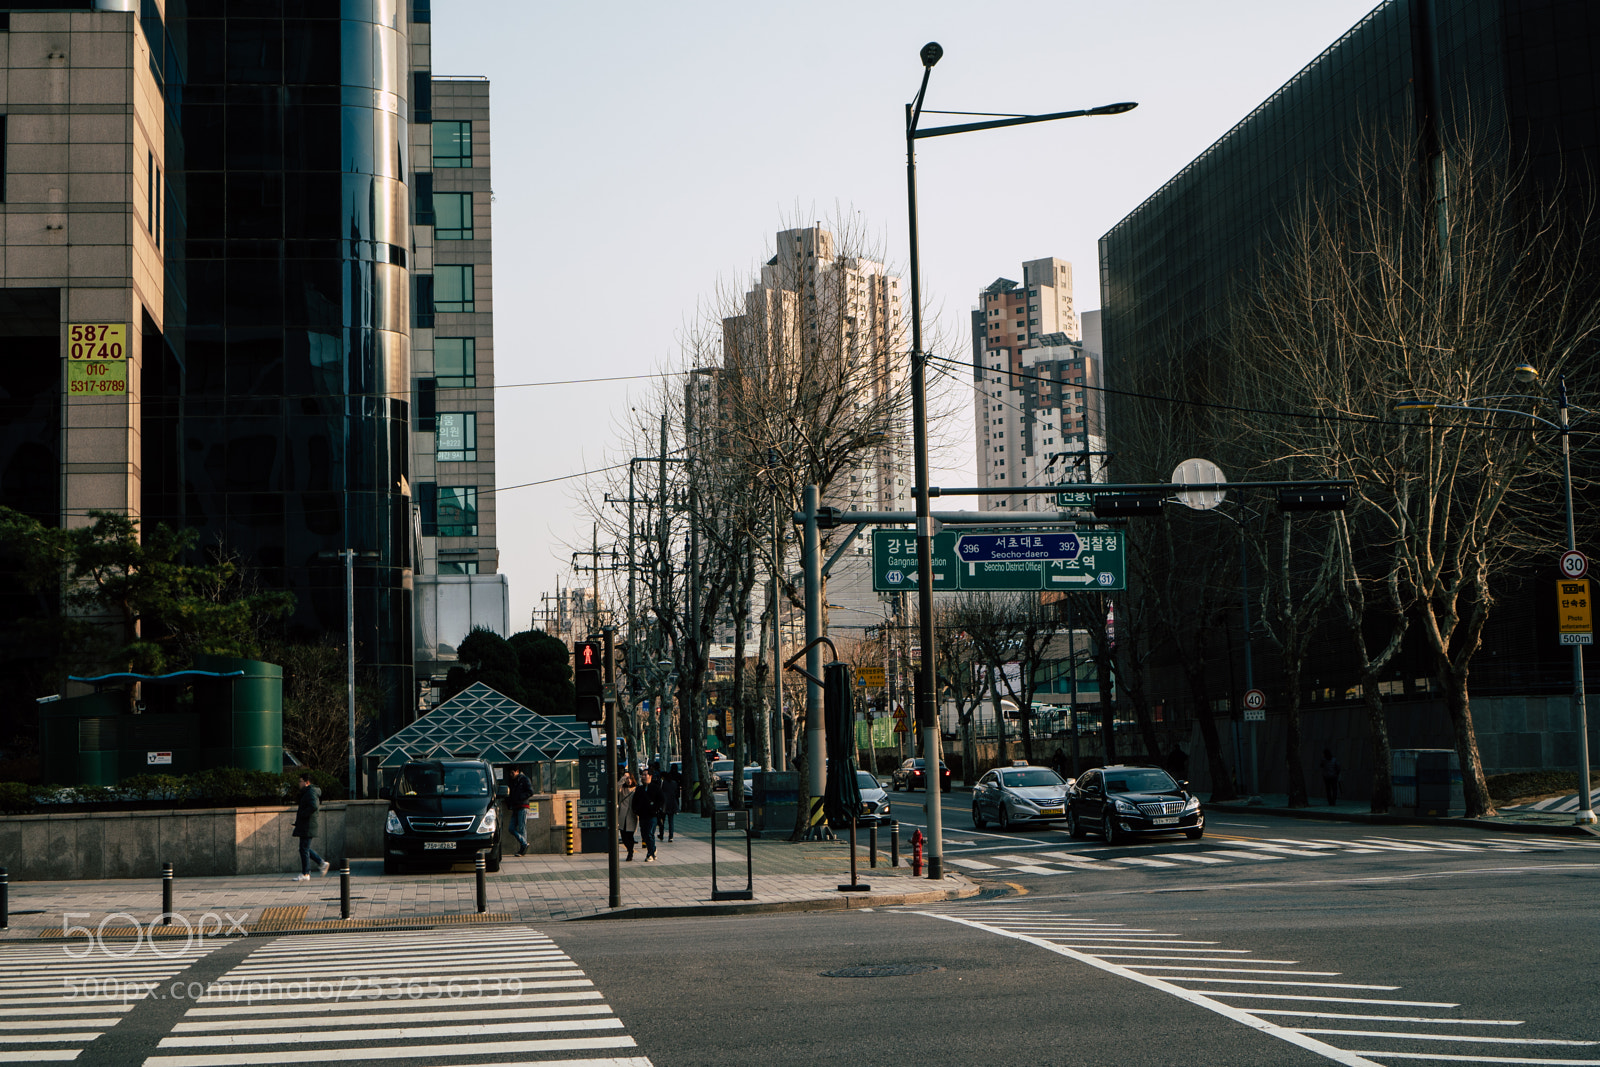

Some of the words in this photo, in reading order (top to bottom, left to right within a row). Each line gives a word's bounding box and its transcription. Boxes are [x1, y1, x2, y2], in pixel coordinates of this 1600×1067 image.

[71, 325, 118, 341] 587-
[71, 342, 122, 359] 0740
[86, 364, 109, 375] 010-
[70, 380, 125, 392] 5317-8789
[888, 539, 935, 554] 강남
[995, 536, 1044, 549] 서초대로
[1059, 541, 1076, 551] 392
[962, 544, 980, 553] 396
[991, 550, 1049, 558] Seocho-daero
[931, 558, 947, 566] ation
[984, 562, 1004, 571] Seocho
[1005, 561, 1025, 571] District
[1026, 561, 1041, 571] Office
[1566, 558, 1583, 571] 30
[890, 573, 900, 581] 41
[1101, 575, 1111, 583] 31
[1563, 634, 1590, 643] 500m
[1248, 695, 1261, 705] 40
[587, 758, 600, 796] 식당가
